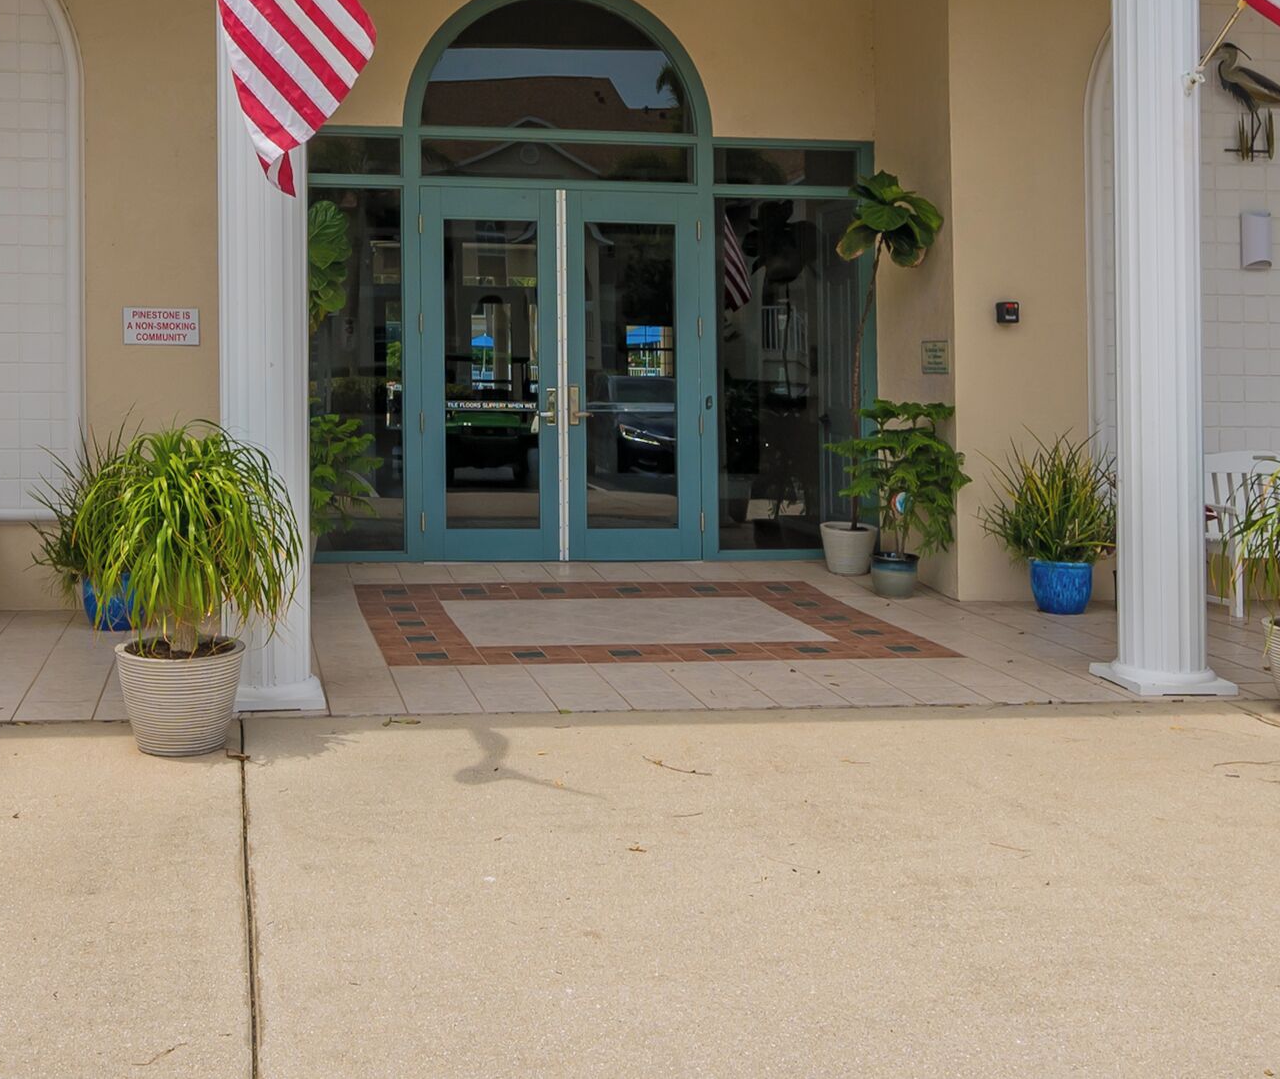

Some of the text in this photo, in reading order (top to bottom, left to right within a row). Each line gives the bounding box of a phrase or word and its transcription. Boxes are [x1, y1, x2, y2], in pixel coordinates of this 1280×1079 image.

[132, 310, 191, 320] PINESTONE IS
[127, 322, 196, 331] A NON-SMOKING
[136, 333, 187, 341] COMMUNITY
